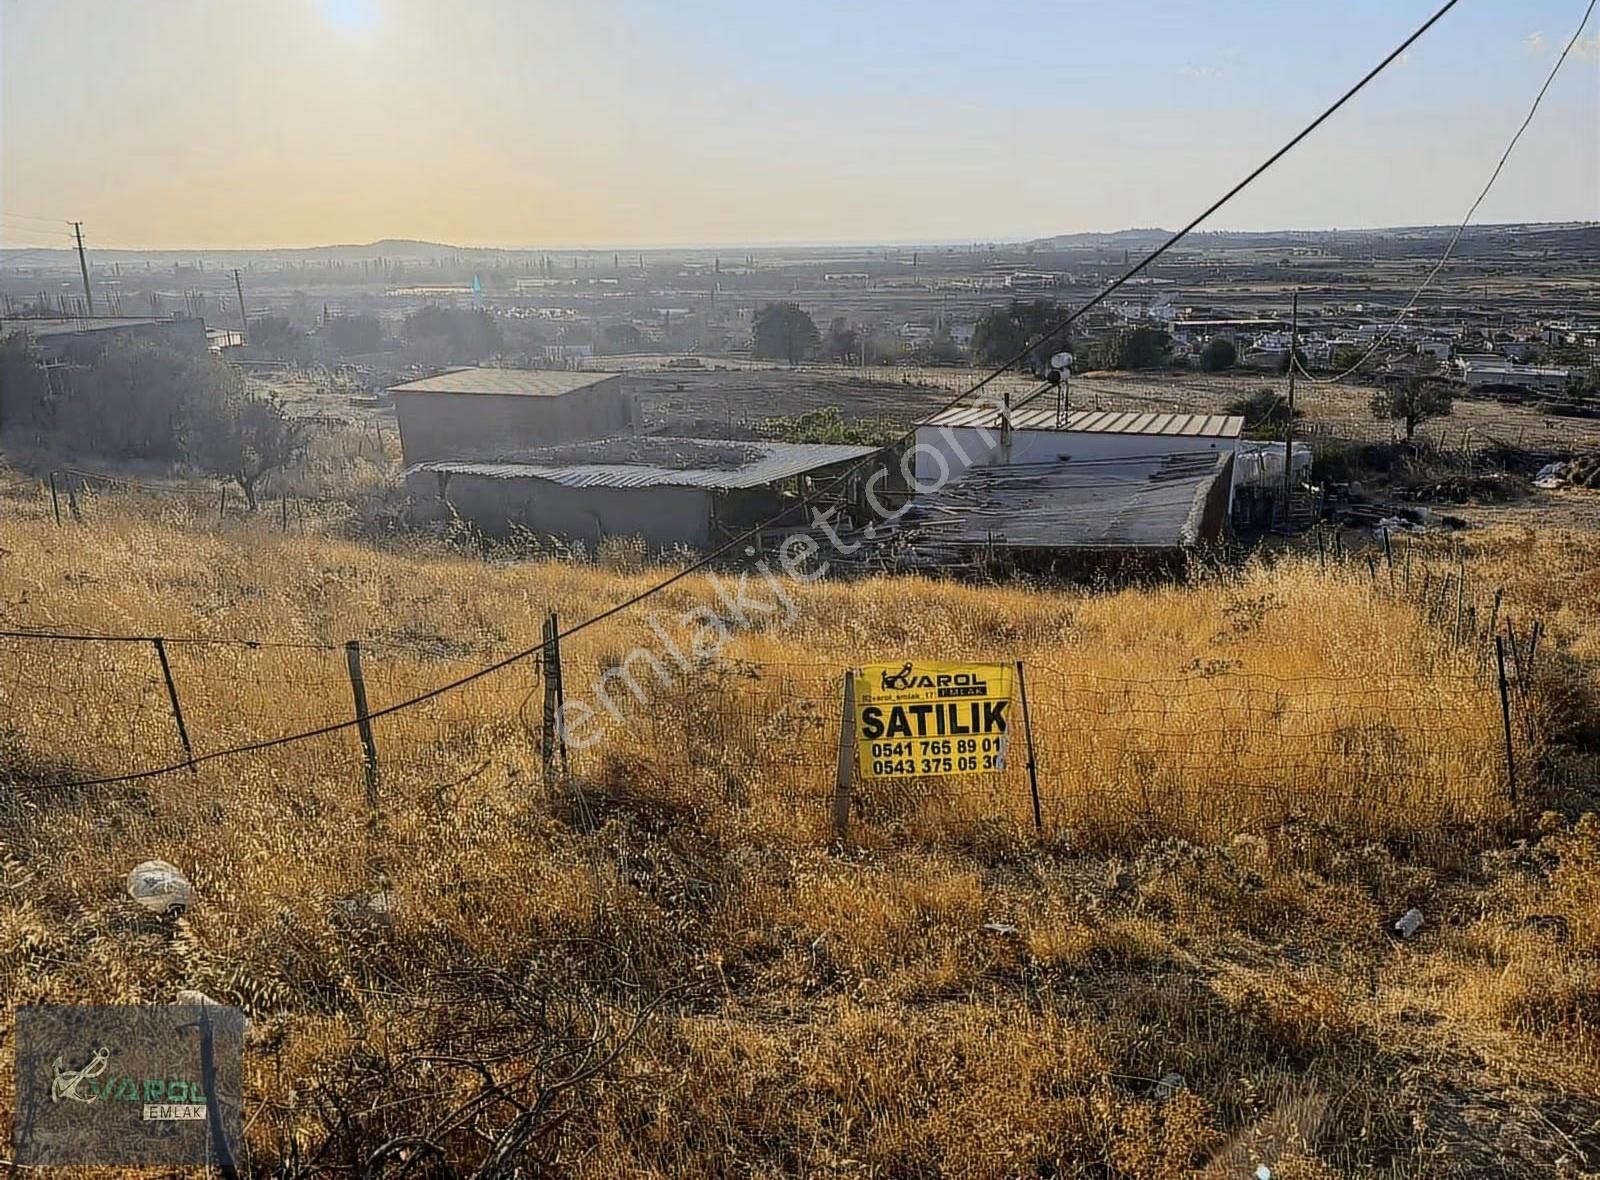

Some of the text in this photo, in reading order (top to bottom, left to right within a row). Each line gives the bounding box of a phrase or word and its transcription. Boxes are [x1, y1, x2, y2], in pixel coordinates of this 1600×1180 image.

[903, 673, 987, 688] VAROL
[861, 701, 1009, 739] SATILIK
[872, 738, 1000, 758] 0541 765 89 01
[873, 759, 915, 775] 0543
[921, 757, 952, 774] 375
[958, 756, 977, 771] 05
